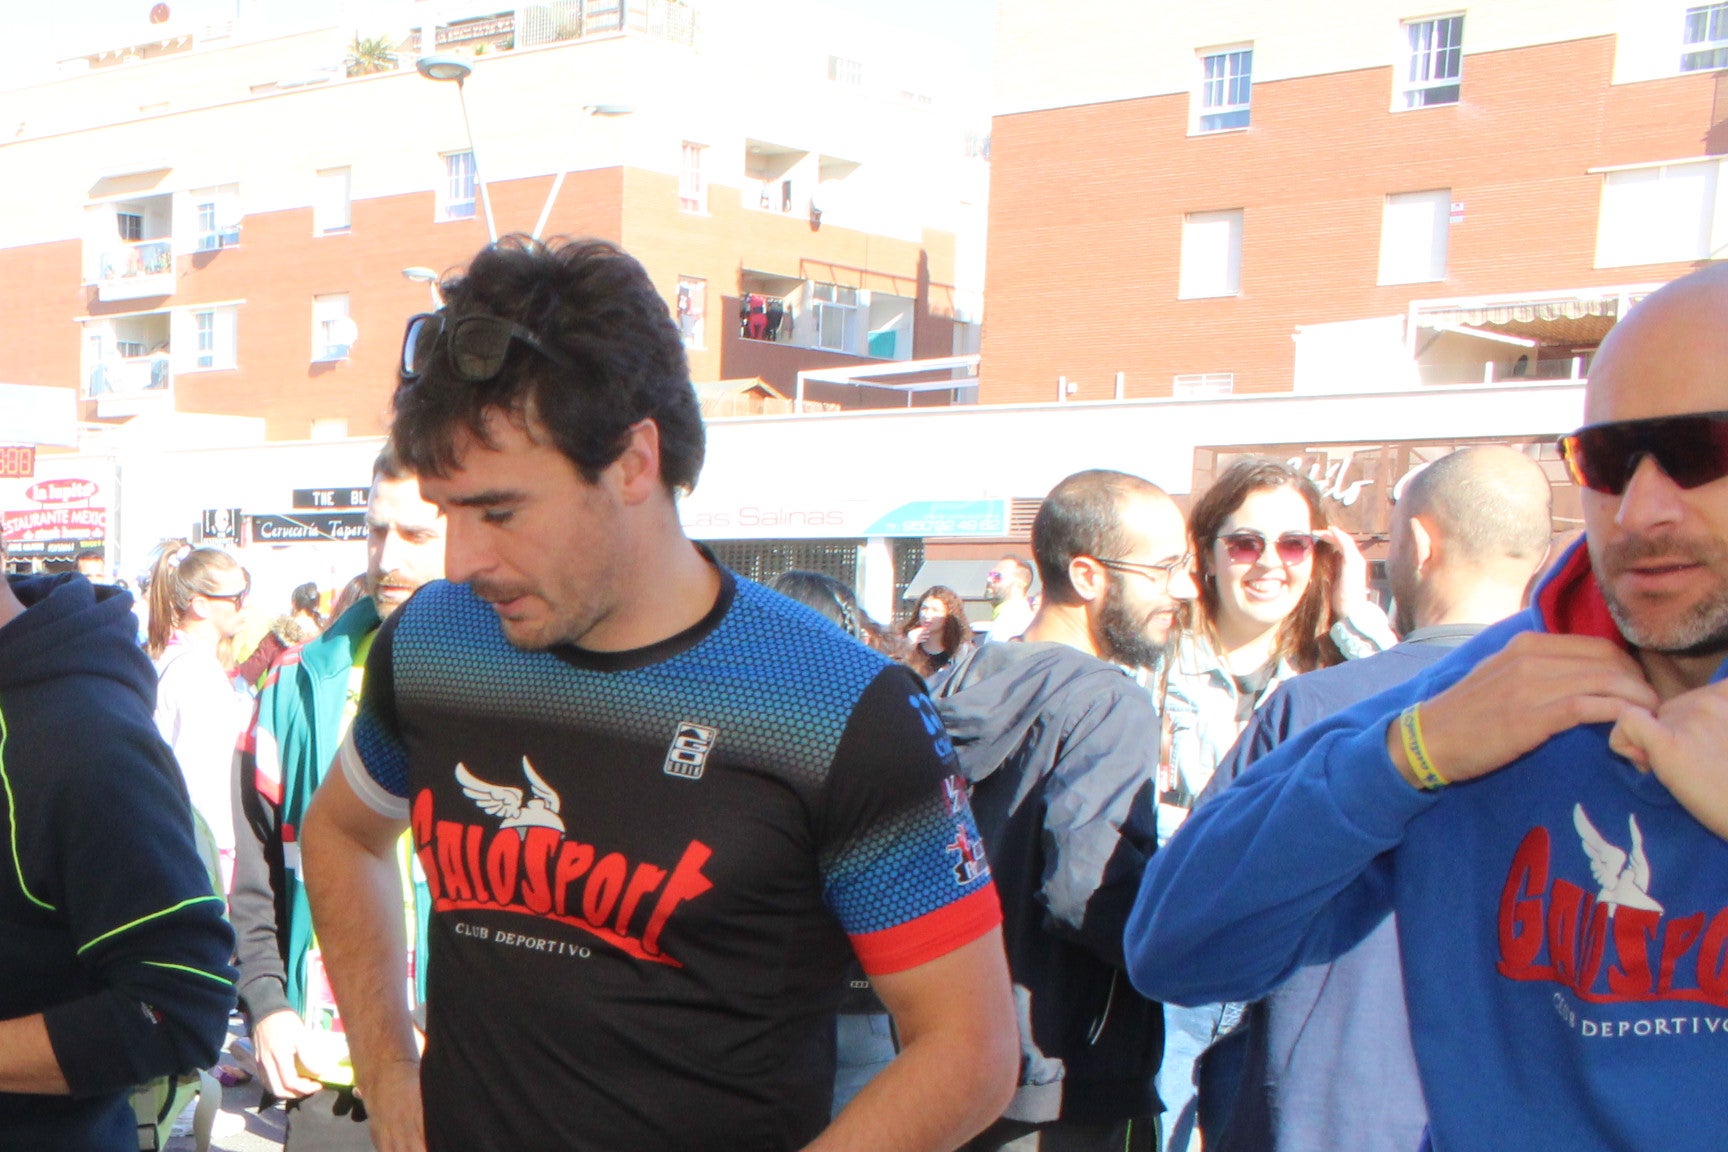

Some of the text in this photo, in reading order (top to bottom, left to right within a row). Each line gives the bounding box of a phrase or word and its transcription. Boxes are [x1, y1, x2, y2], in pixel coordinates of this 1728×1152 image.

[312, 491, 335, 505] THE
[738, 506, 844, 527] Salinas
[455, 922, 592, 959] CLUB DEPORTIVO
